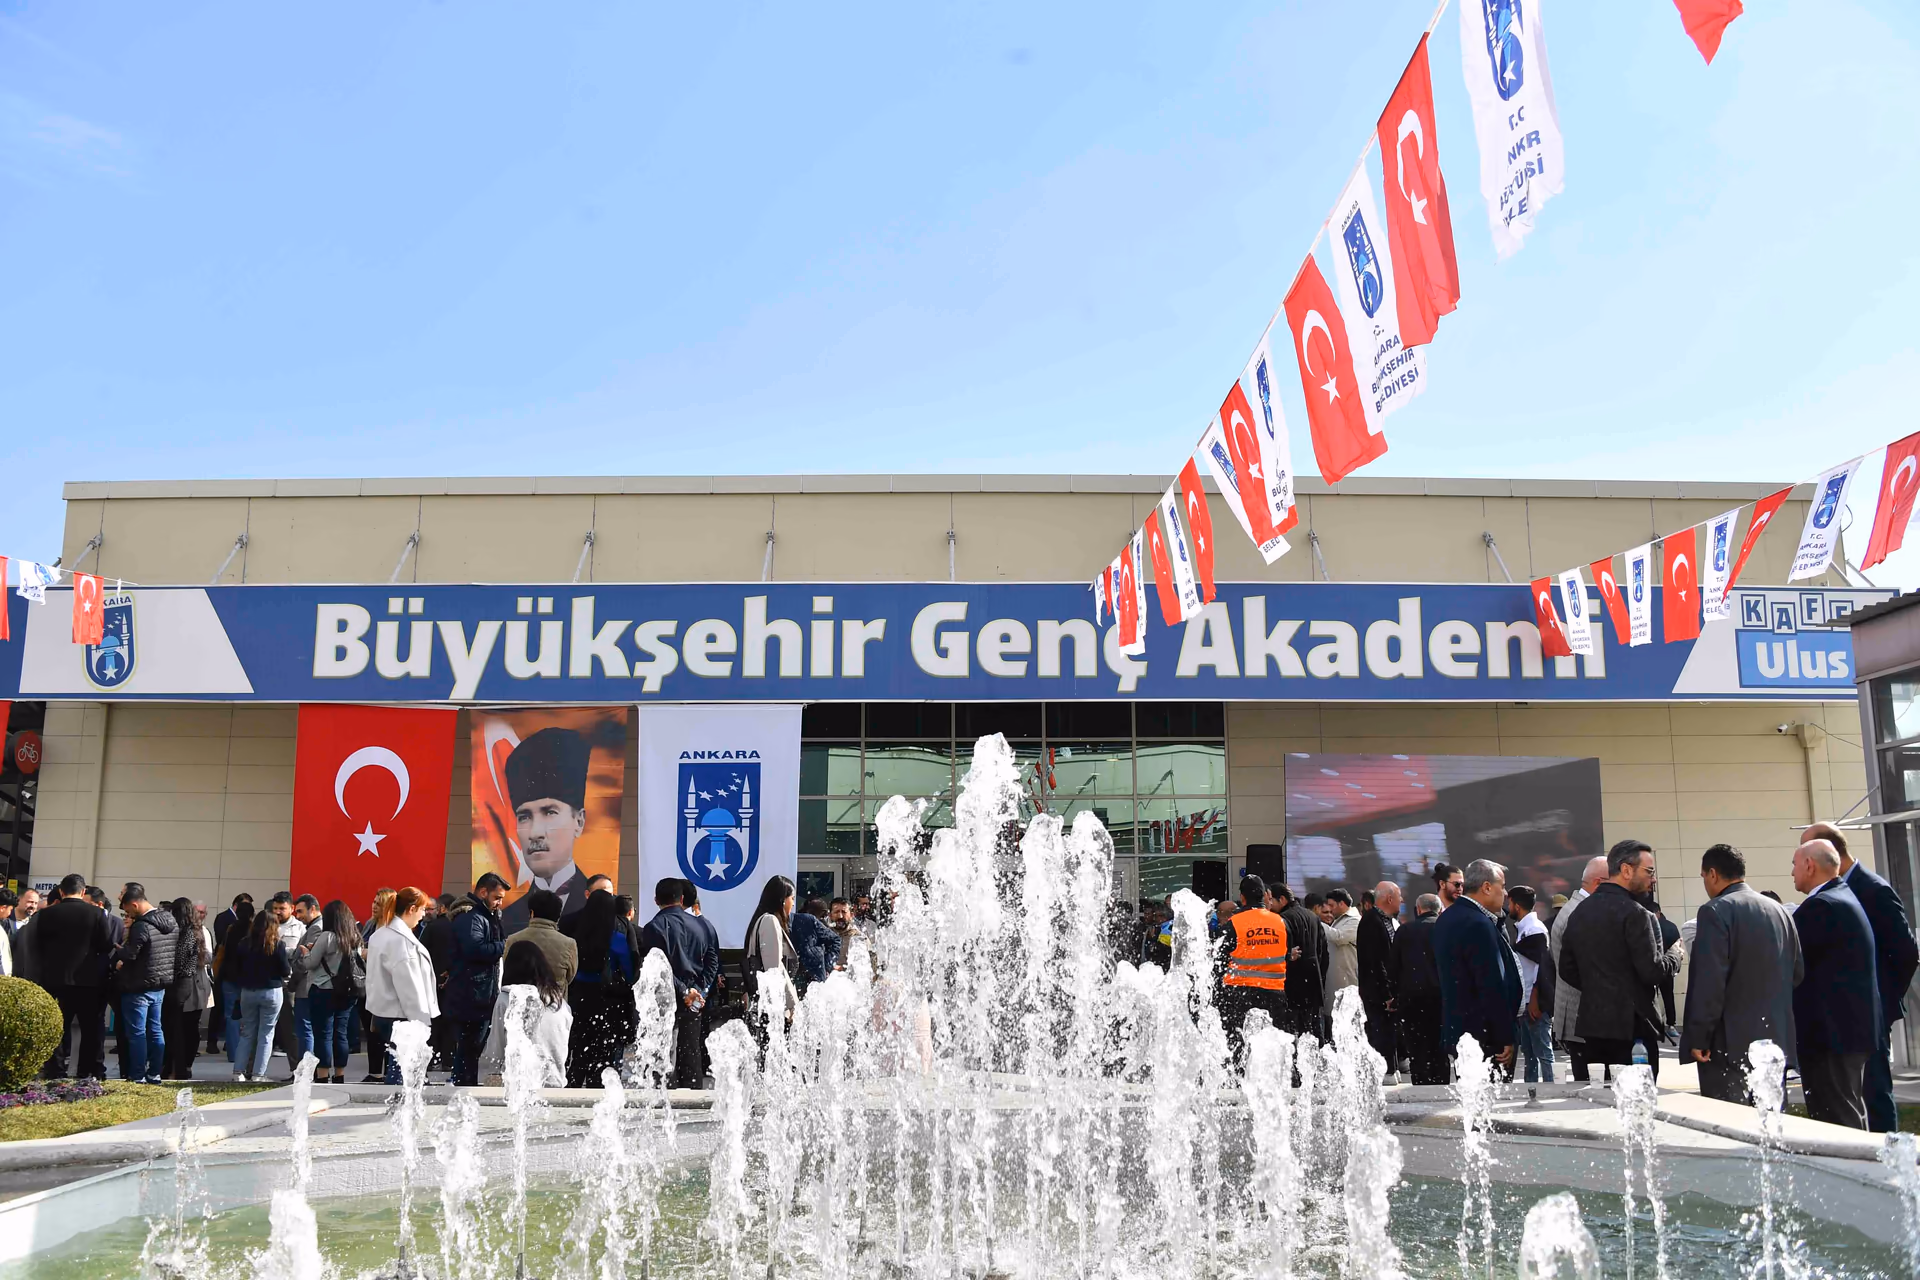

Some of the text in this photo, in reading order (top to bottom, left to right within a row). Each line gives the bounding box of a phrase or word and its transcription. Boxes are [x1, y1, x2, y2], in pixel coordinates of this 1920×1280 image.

[312, 595, 887, 700] Büyükşehir
[910, 600, 1148, 693] Genç
[1175, 596, 1607, 680] Akademi
[1755, 639, 1850, 679] Ulus
[679, 750, 761, 760] ANKARA
[1246, 927, 1280, 939] ÖZEL
